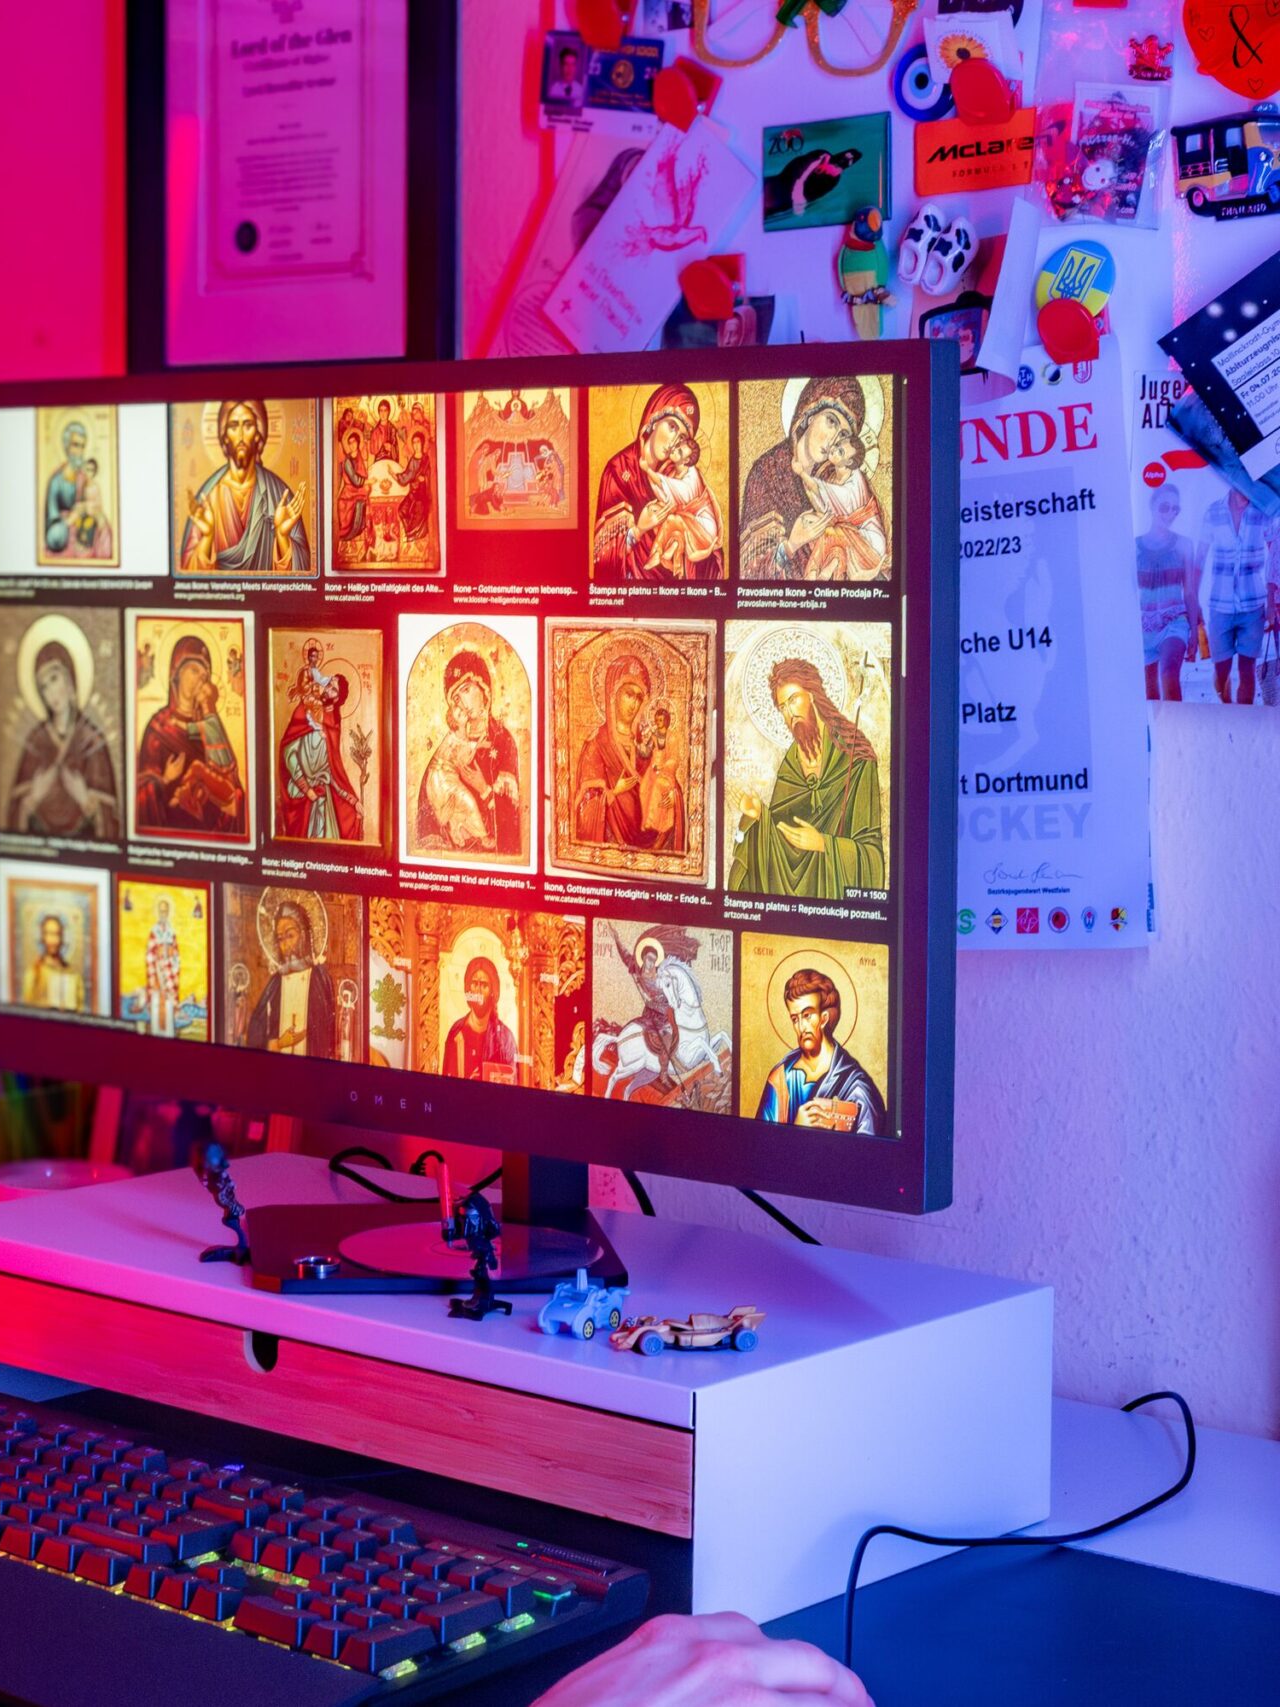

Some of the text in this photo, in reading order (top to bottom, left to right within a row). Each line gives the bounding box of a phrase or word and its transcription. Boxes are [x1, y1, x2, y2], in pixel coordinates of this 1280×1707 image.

[960, 488, 1096, 524] eisterschaft
[478, 585, 523, 594] Gottesmutter
[589, 583, 616, 596] Štampa
[618, 587, 627, 595] na
[628, 586, 652, 597] platnu
[659, 586, 679, 596] Ikone
[737, 587, 783, 597] Pravoslavne
[785, 587, 806, 597] Ikone
[814, 587, 839, 598] Online
[841, 588, 871, 600] Prodaja
[589, 598, 624, 606] artzona.net
[960, 626, 1052, 654] che U14
[962, 702, 1017, 724] Platz
[975, 767, 1088, 794] Dortmund
[399, 869, 417, 879] Ikone
[418, 871, 448, 882] Madonna
[449, 874, 460, 883] mit
[461, 875, 477, 885] Kind
[478, 876, 490, 886] auf
[544, 882, 565, 894] Ikone,
[566, 884, 613, 897] Gottesmutter
[656, 891, 673, 902] Holz
[680, 894, 699, 904] Ende
[544, 894, 600, 906] www.catawiki.com
[846, 888, 862, 898] 1071
[869, 890, 887, 900] 1500
[724, 895, 752, 910] Štampa
[754, 901, 764, 910] na
[765, 901, 790, 912] platnu
[798, 904, 849, 919] Reprodukcije
[724, 911, 761, 921] artzona.net
[350, 1090, 432, 1112] OMEN
